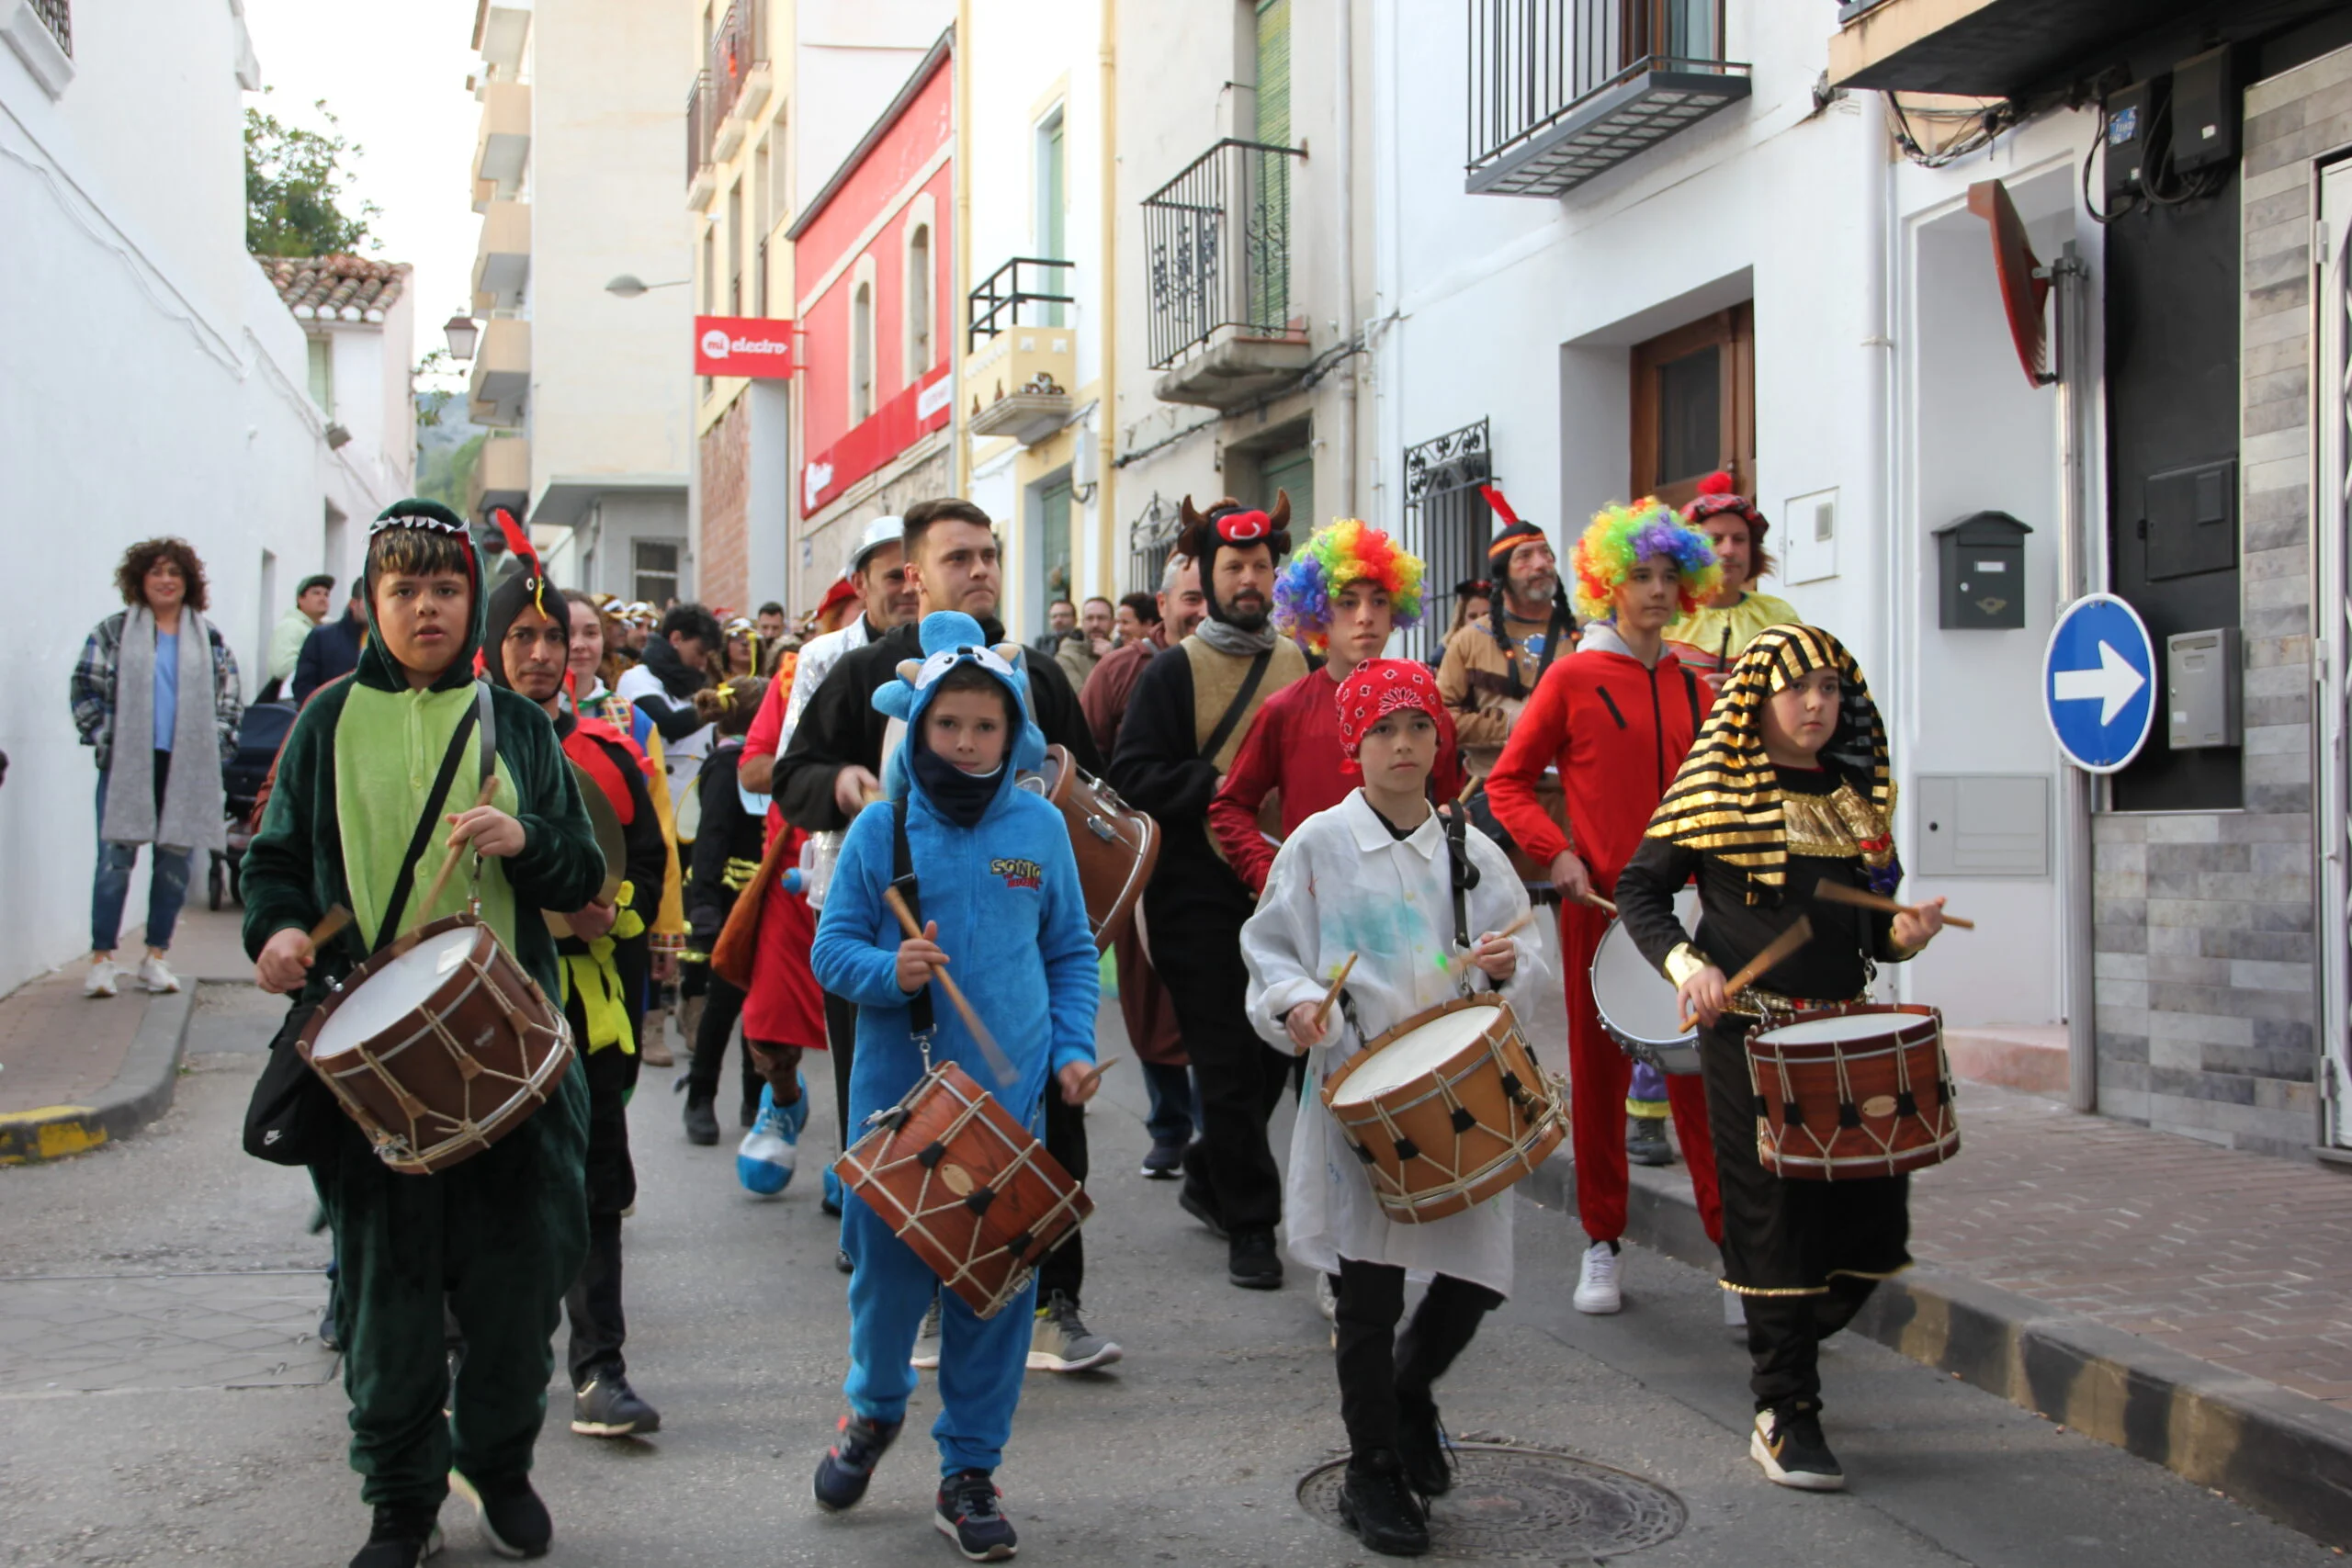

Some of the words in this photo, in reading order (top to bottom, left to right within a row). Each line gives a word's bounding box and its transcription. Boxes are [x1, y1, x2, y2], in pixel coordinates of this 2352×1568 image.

[707, 338, 725, 350] mi
[731, 336, 787, 355] electro
[990, 858, 1040, 878] SONIC
